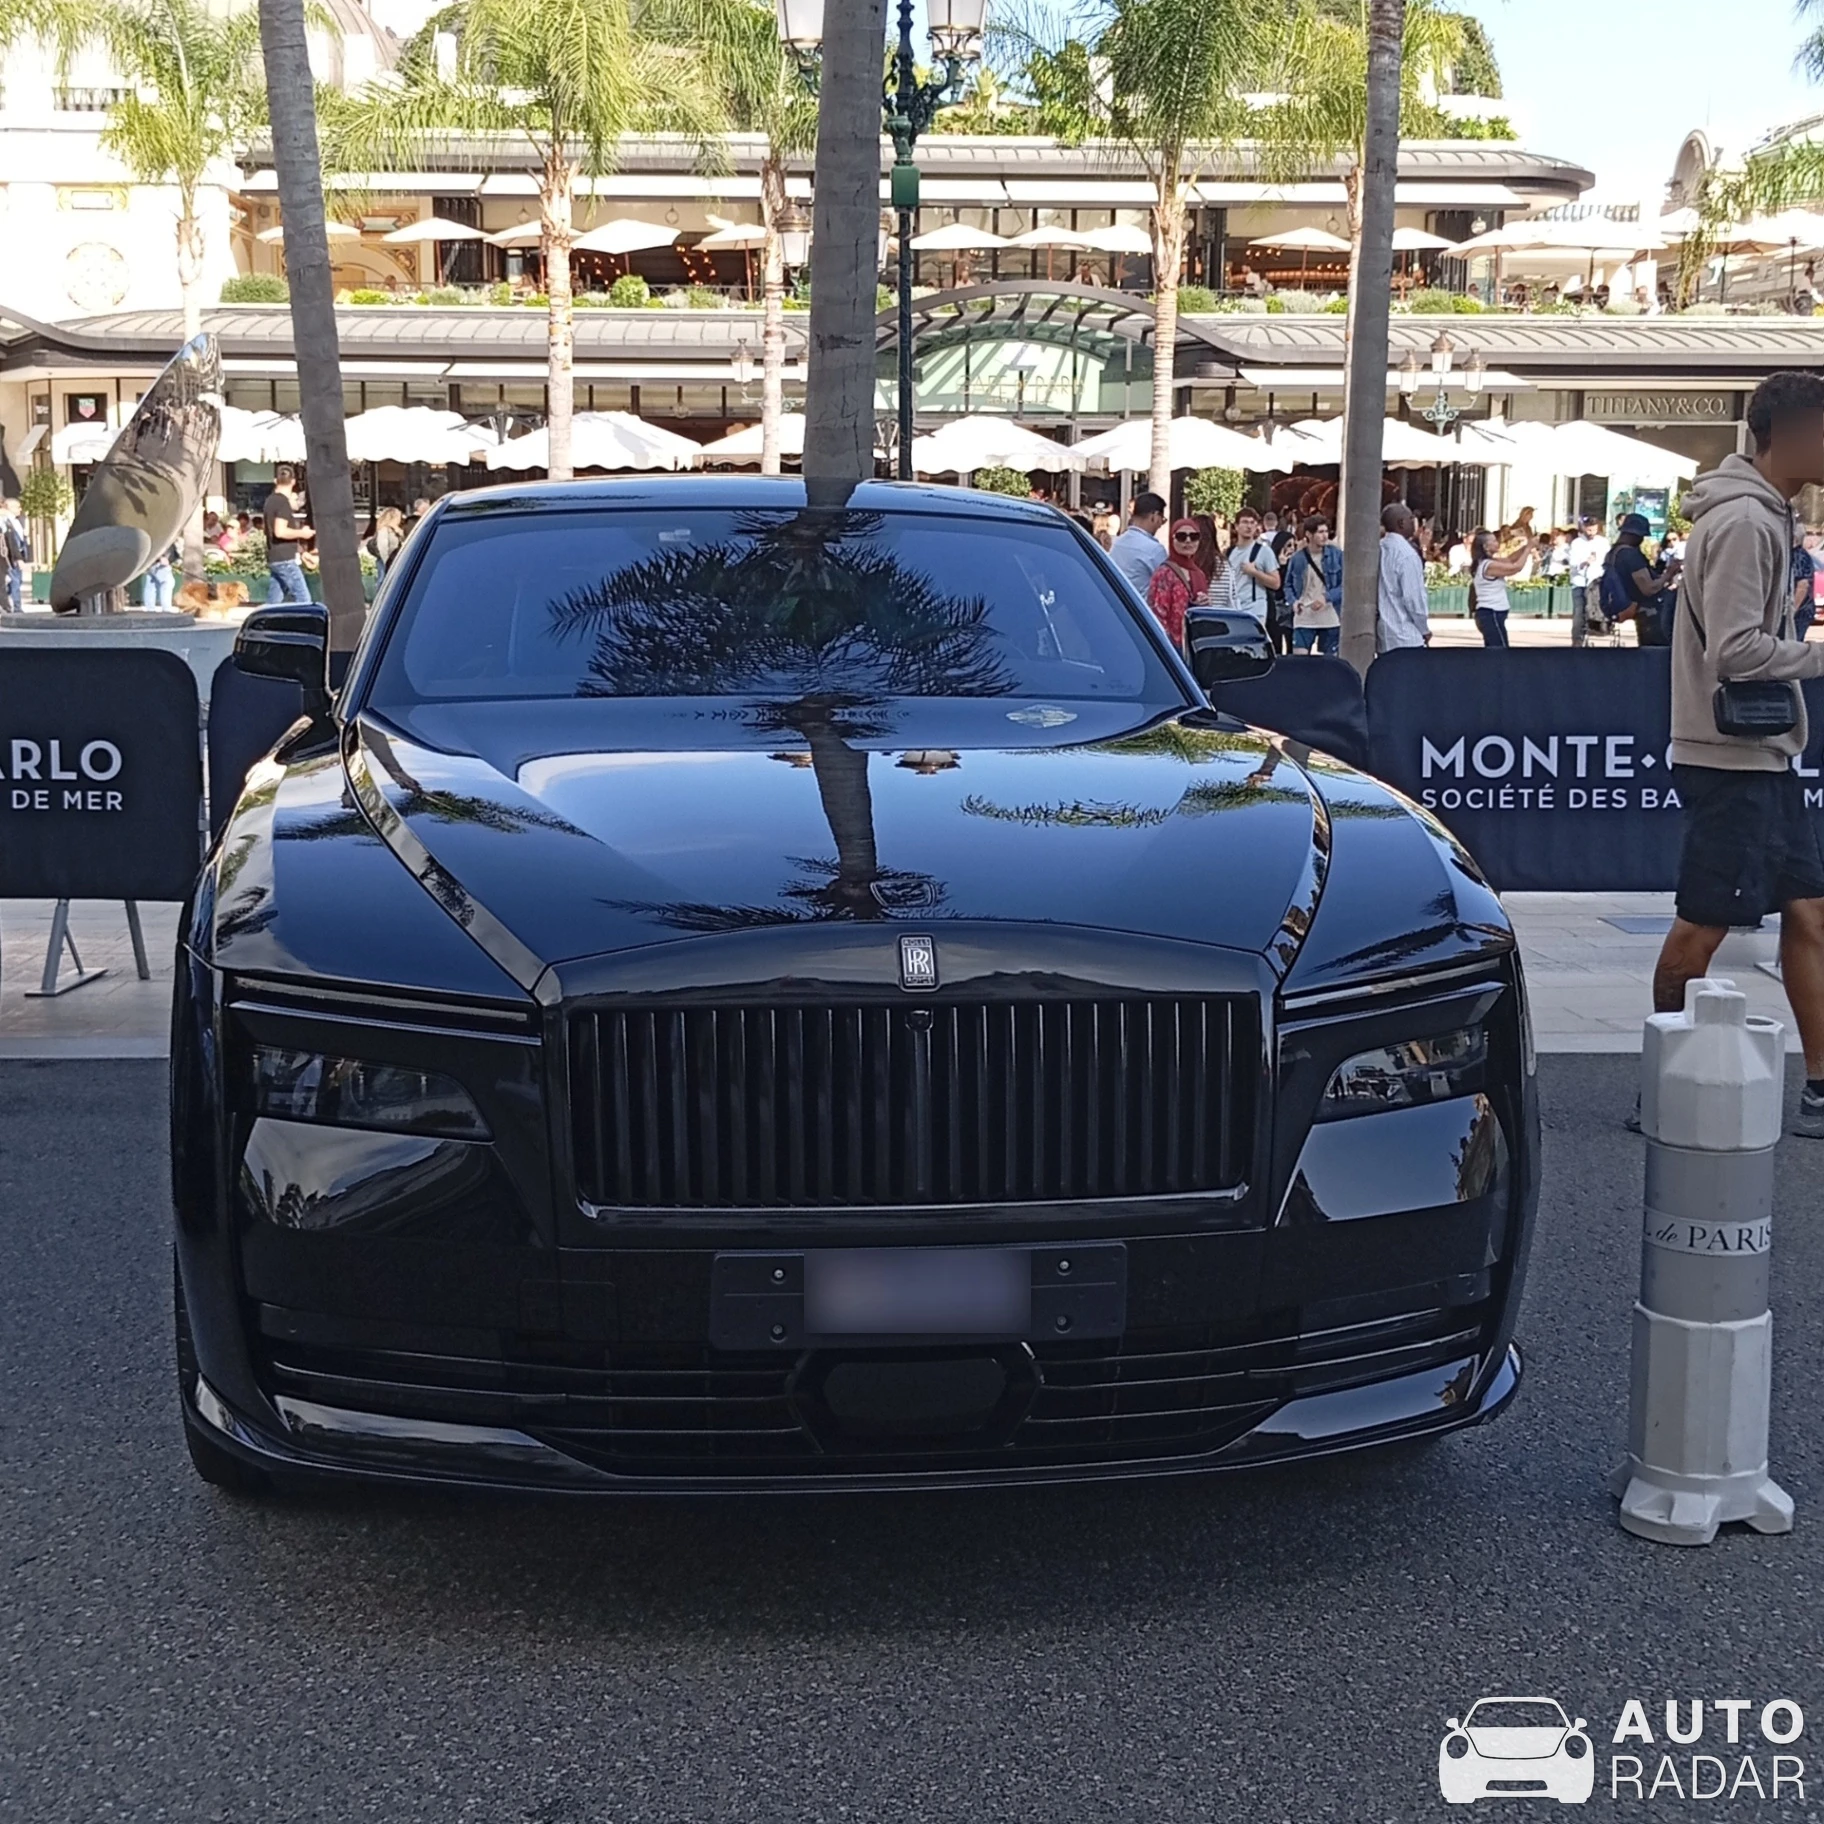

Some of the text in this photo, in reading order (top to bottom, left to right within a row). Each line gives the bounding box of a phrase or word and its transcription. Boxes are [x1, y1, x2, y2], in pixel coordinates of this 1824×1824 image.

[0, 739, 122, 781] RLO
[12, 789, 123, 811] DE MER
[1422, 783, 1555, 809] SOCIÉTÉ
[1569, 788, 1628, 809] DES
[1656, 1222, 1678, 1243] de
